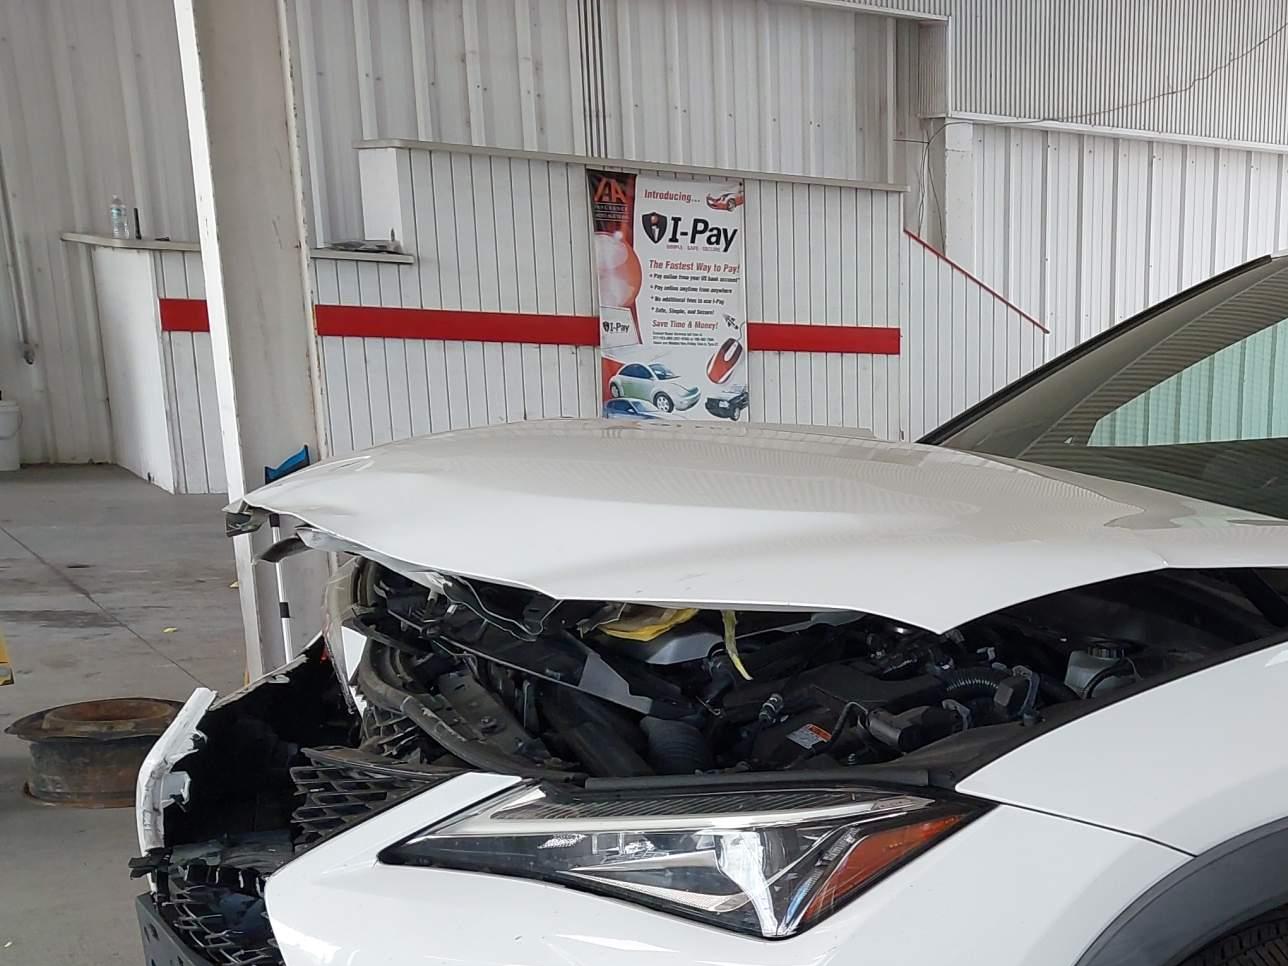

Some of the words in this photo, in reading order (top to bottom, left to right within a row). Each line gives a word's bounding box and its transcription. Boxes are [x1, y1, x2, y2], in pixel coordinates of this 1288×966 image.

[668, 216, 738, 252] I-Pay
[649, 259, 663, 269] The
[665, 261, 694, 270] Fastest
[696, 262, 712, 273] Way
[714, 263, 722, 272] to
[723, 264, 740, 274] Pay!
[610, 322, 630, 333] I-Pay
[670, 320, 686, 328] Time
[694, 321, 719, 330] Money!
